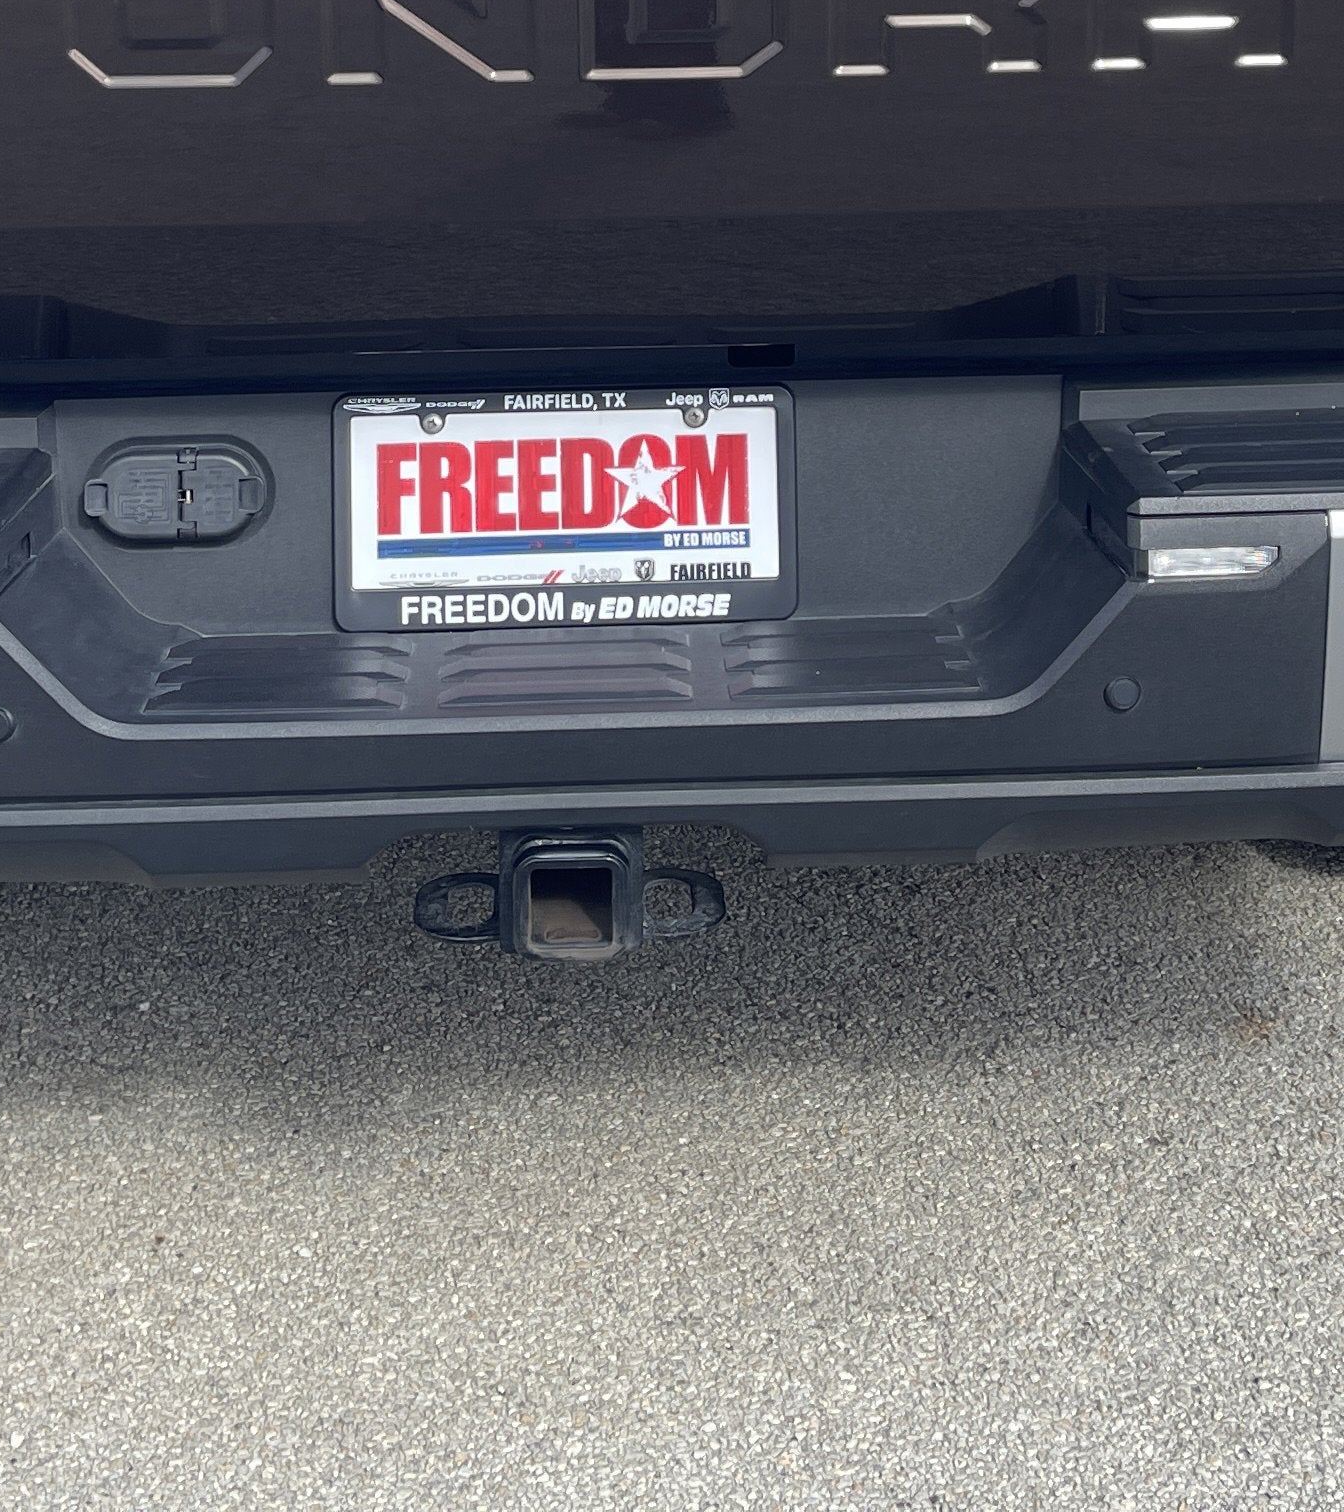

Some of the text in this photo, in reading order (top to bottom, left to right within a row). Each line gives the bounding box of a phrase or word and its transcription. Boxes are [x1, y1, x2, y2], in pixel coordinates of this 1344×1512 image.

[503, 392, 627, 411] FAIRFIELD, TX
[665, 392, 704, 408] Jeep
[732, 393, 774, 403] RAM
[376, 433, 751, 535] FREEDOM
[663, 531, 747, 547] BY ED MORSE
[390, 571, 458, 579] CHRYSLER
[571, 565, 623, 583] Jeep
[670, 561, 752, 581] FAIRFIELD
[401, 591, 732, 625] FREEDOM By ED MORSE
